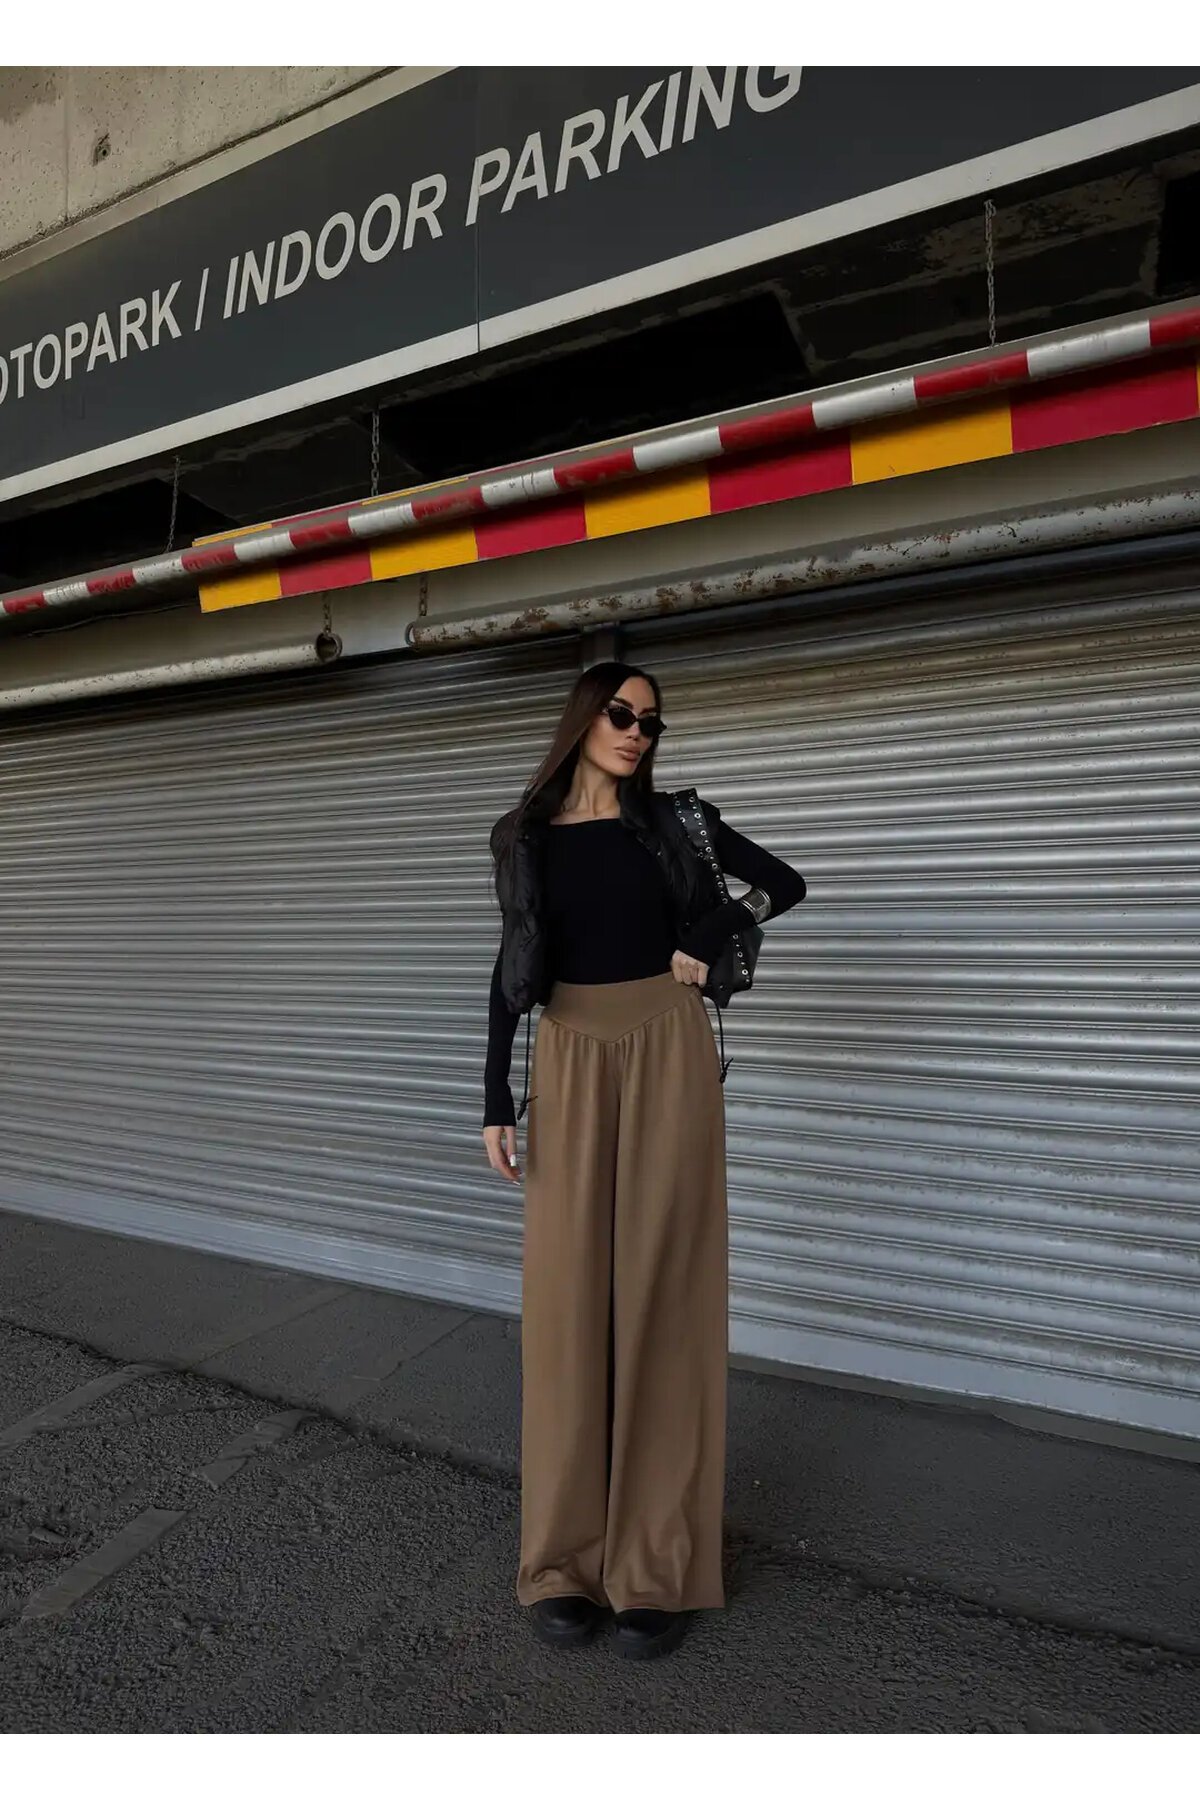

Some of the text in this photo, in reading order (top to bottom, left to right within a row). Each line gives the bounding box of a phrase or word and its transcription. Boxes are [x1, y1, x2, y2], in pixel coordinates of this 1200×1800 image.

[194, 267, 210, 332] /
[222, 173, 447, 320] INDOOR
[465, 66, 803, 227] PARKING
